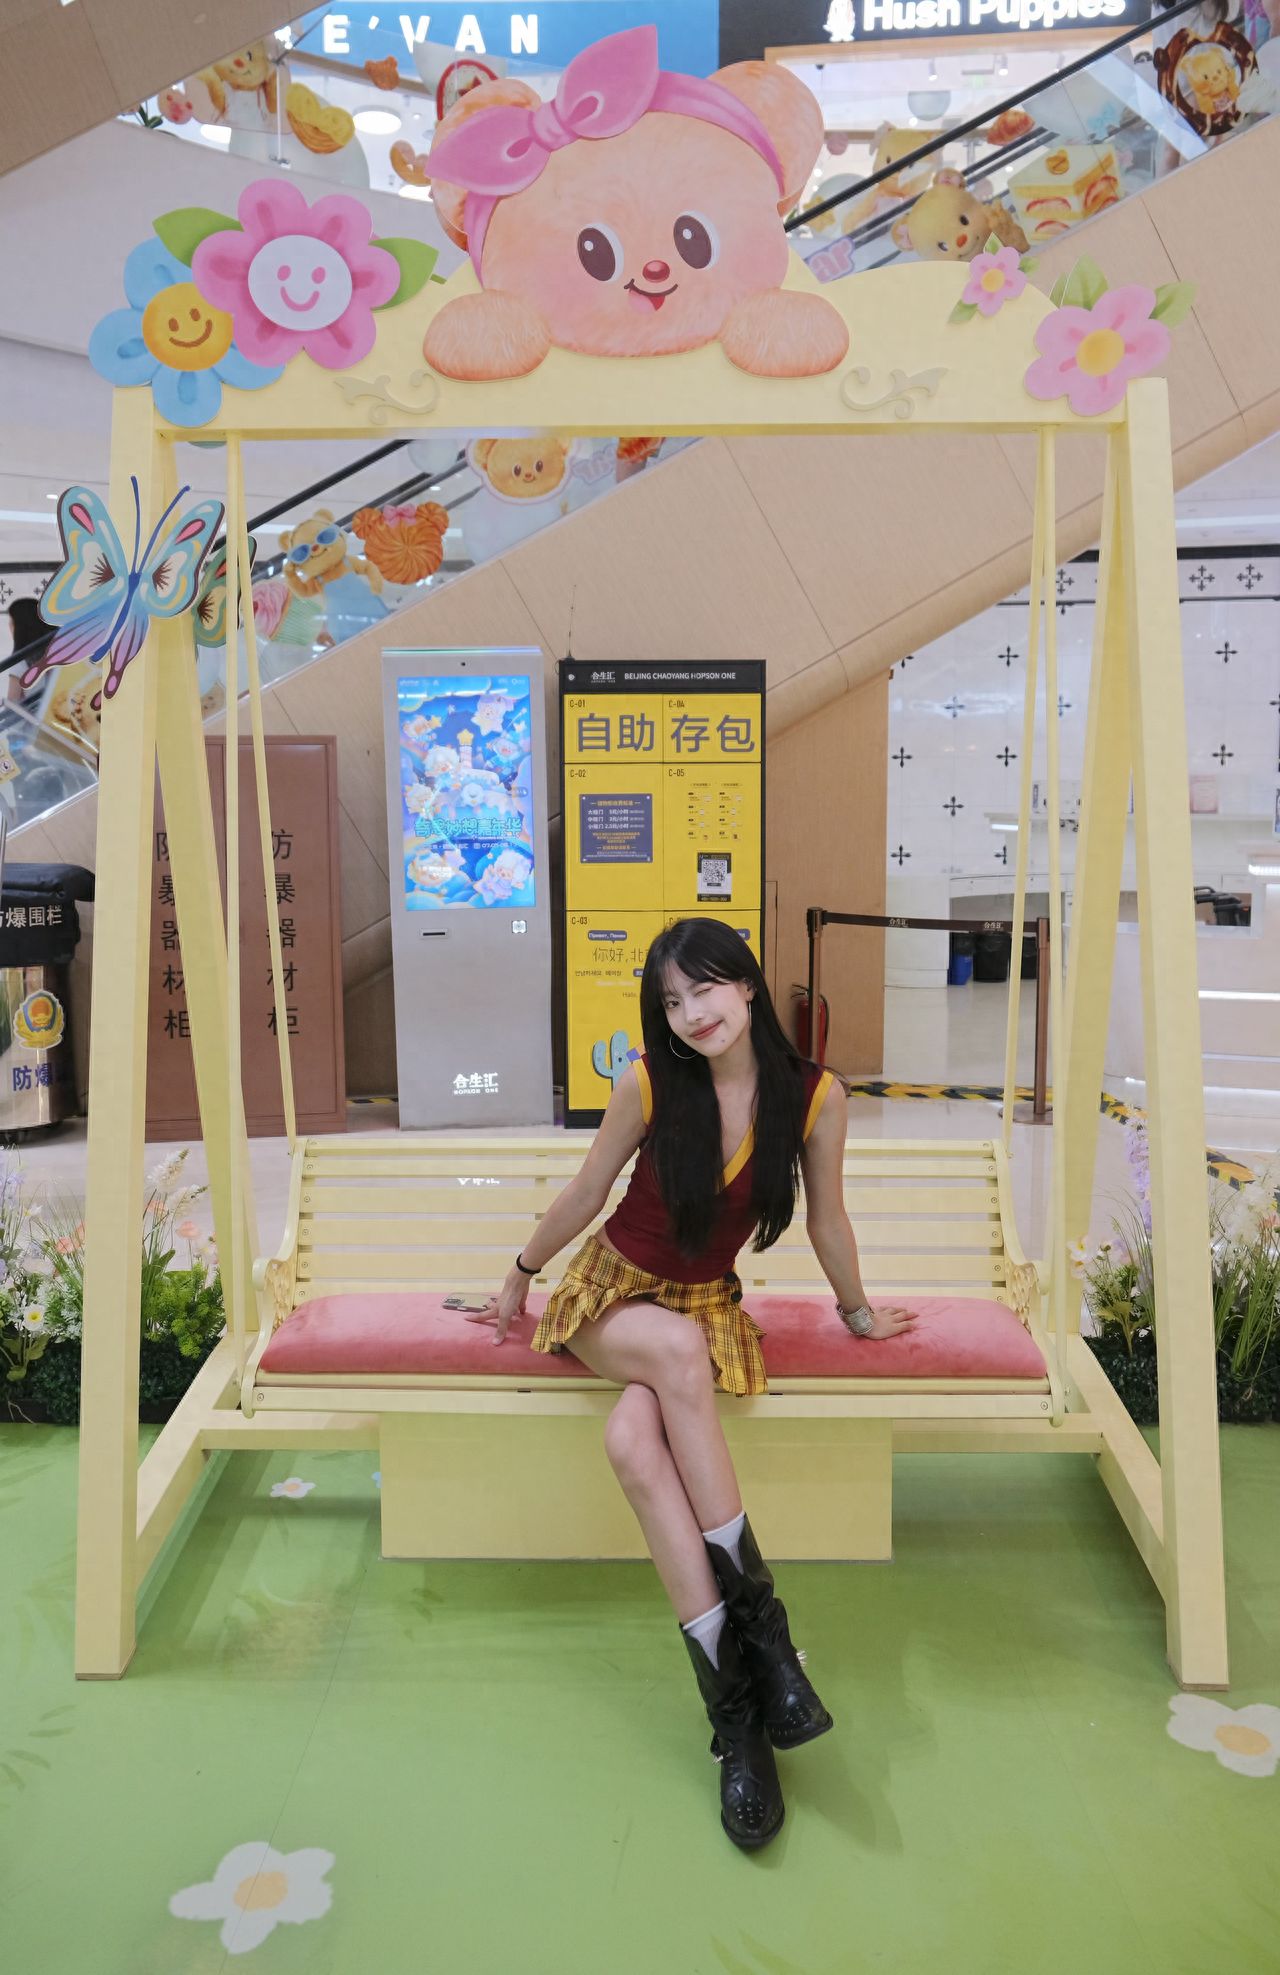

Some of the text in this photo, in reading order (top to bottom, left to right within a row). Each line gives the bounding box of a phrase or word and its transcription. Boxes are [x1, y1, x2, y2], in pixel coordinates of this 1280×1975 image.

[863, 0, 1126, 31] Hush Puppies
[624, 672, 736, 680] BEIJING CHAOYANG HOPSON ONE
[569, 699, 586, 708] C-01
[569, 769, 587, 778] C-02
[668, 769, 685, 777] C-05
[0, 905, 63, 929] 爆围栏
[571, 916, 588, 925] C-03
[593, 948, 650, 963] 你好,北
[12, 1062, 53, 1091] 防爆
[453, 1072, 498, 1089] 合生汇
